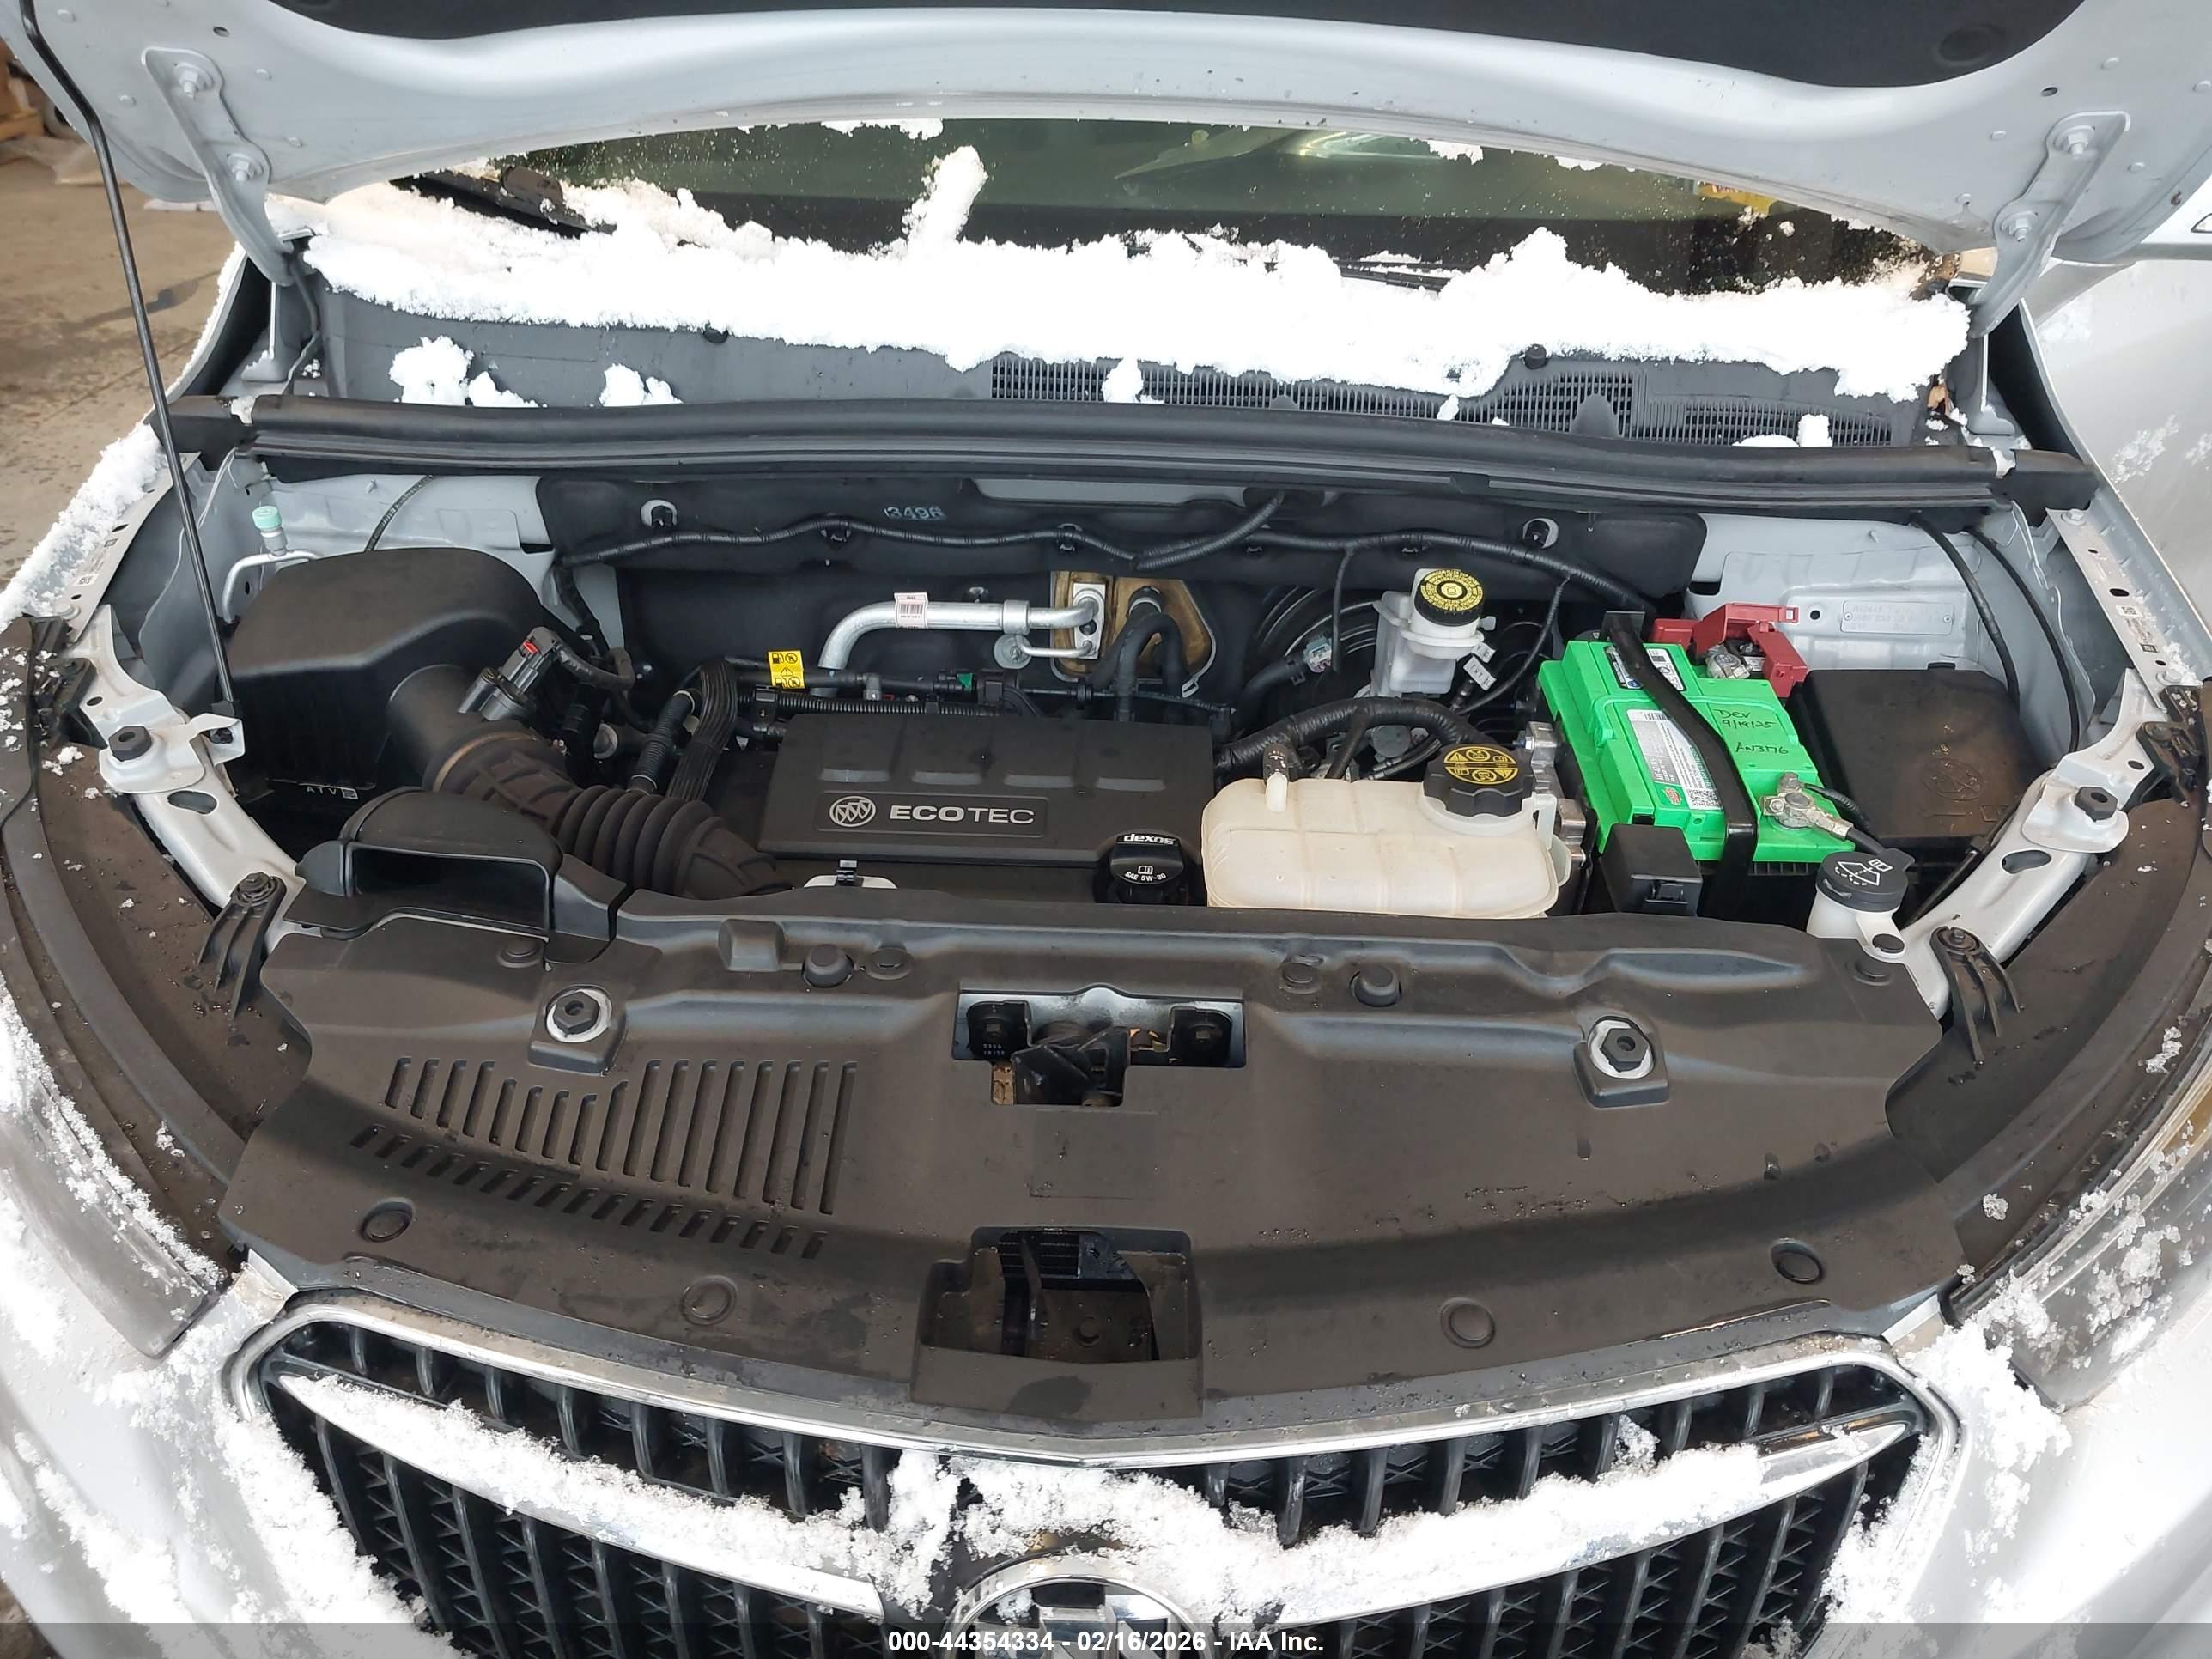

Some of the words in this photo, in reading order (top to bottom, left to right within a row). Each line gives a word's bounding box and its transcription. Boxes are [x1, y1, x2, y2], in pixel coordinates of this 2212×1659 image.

[890, 805, 1035, 824] ECOTEC
[1123, 833, 1176, 845] dexos
[1125, 872, 1139, 880] SAE
[1141, 873, 1166, 882] 5W-30
